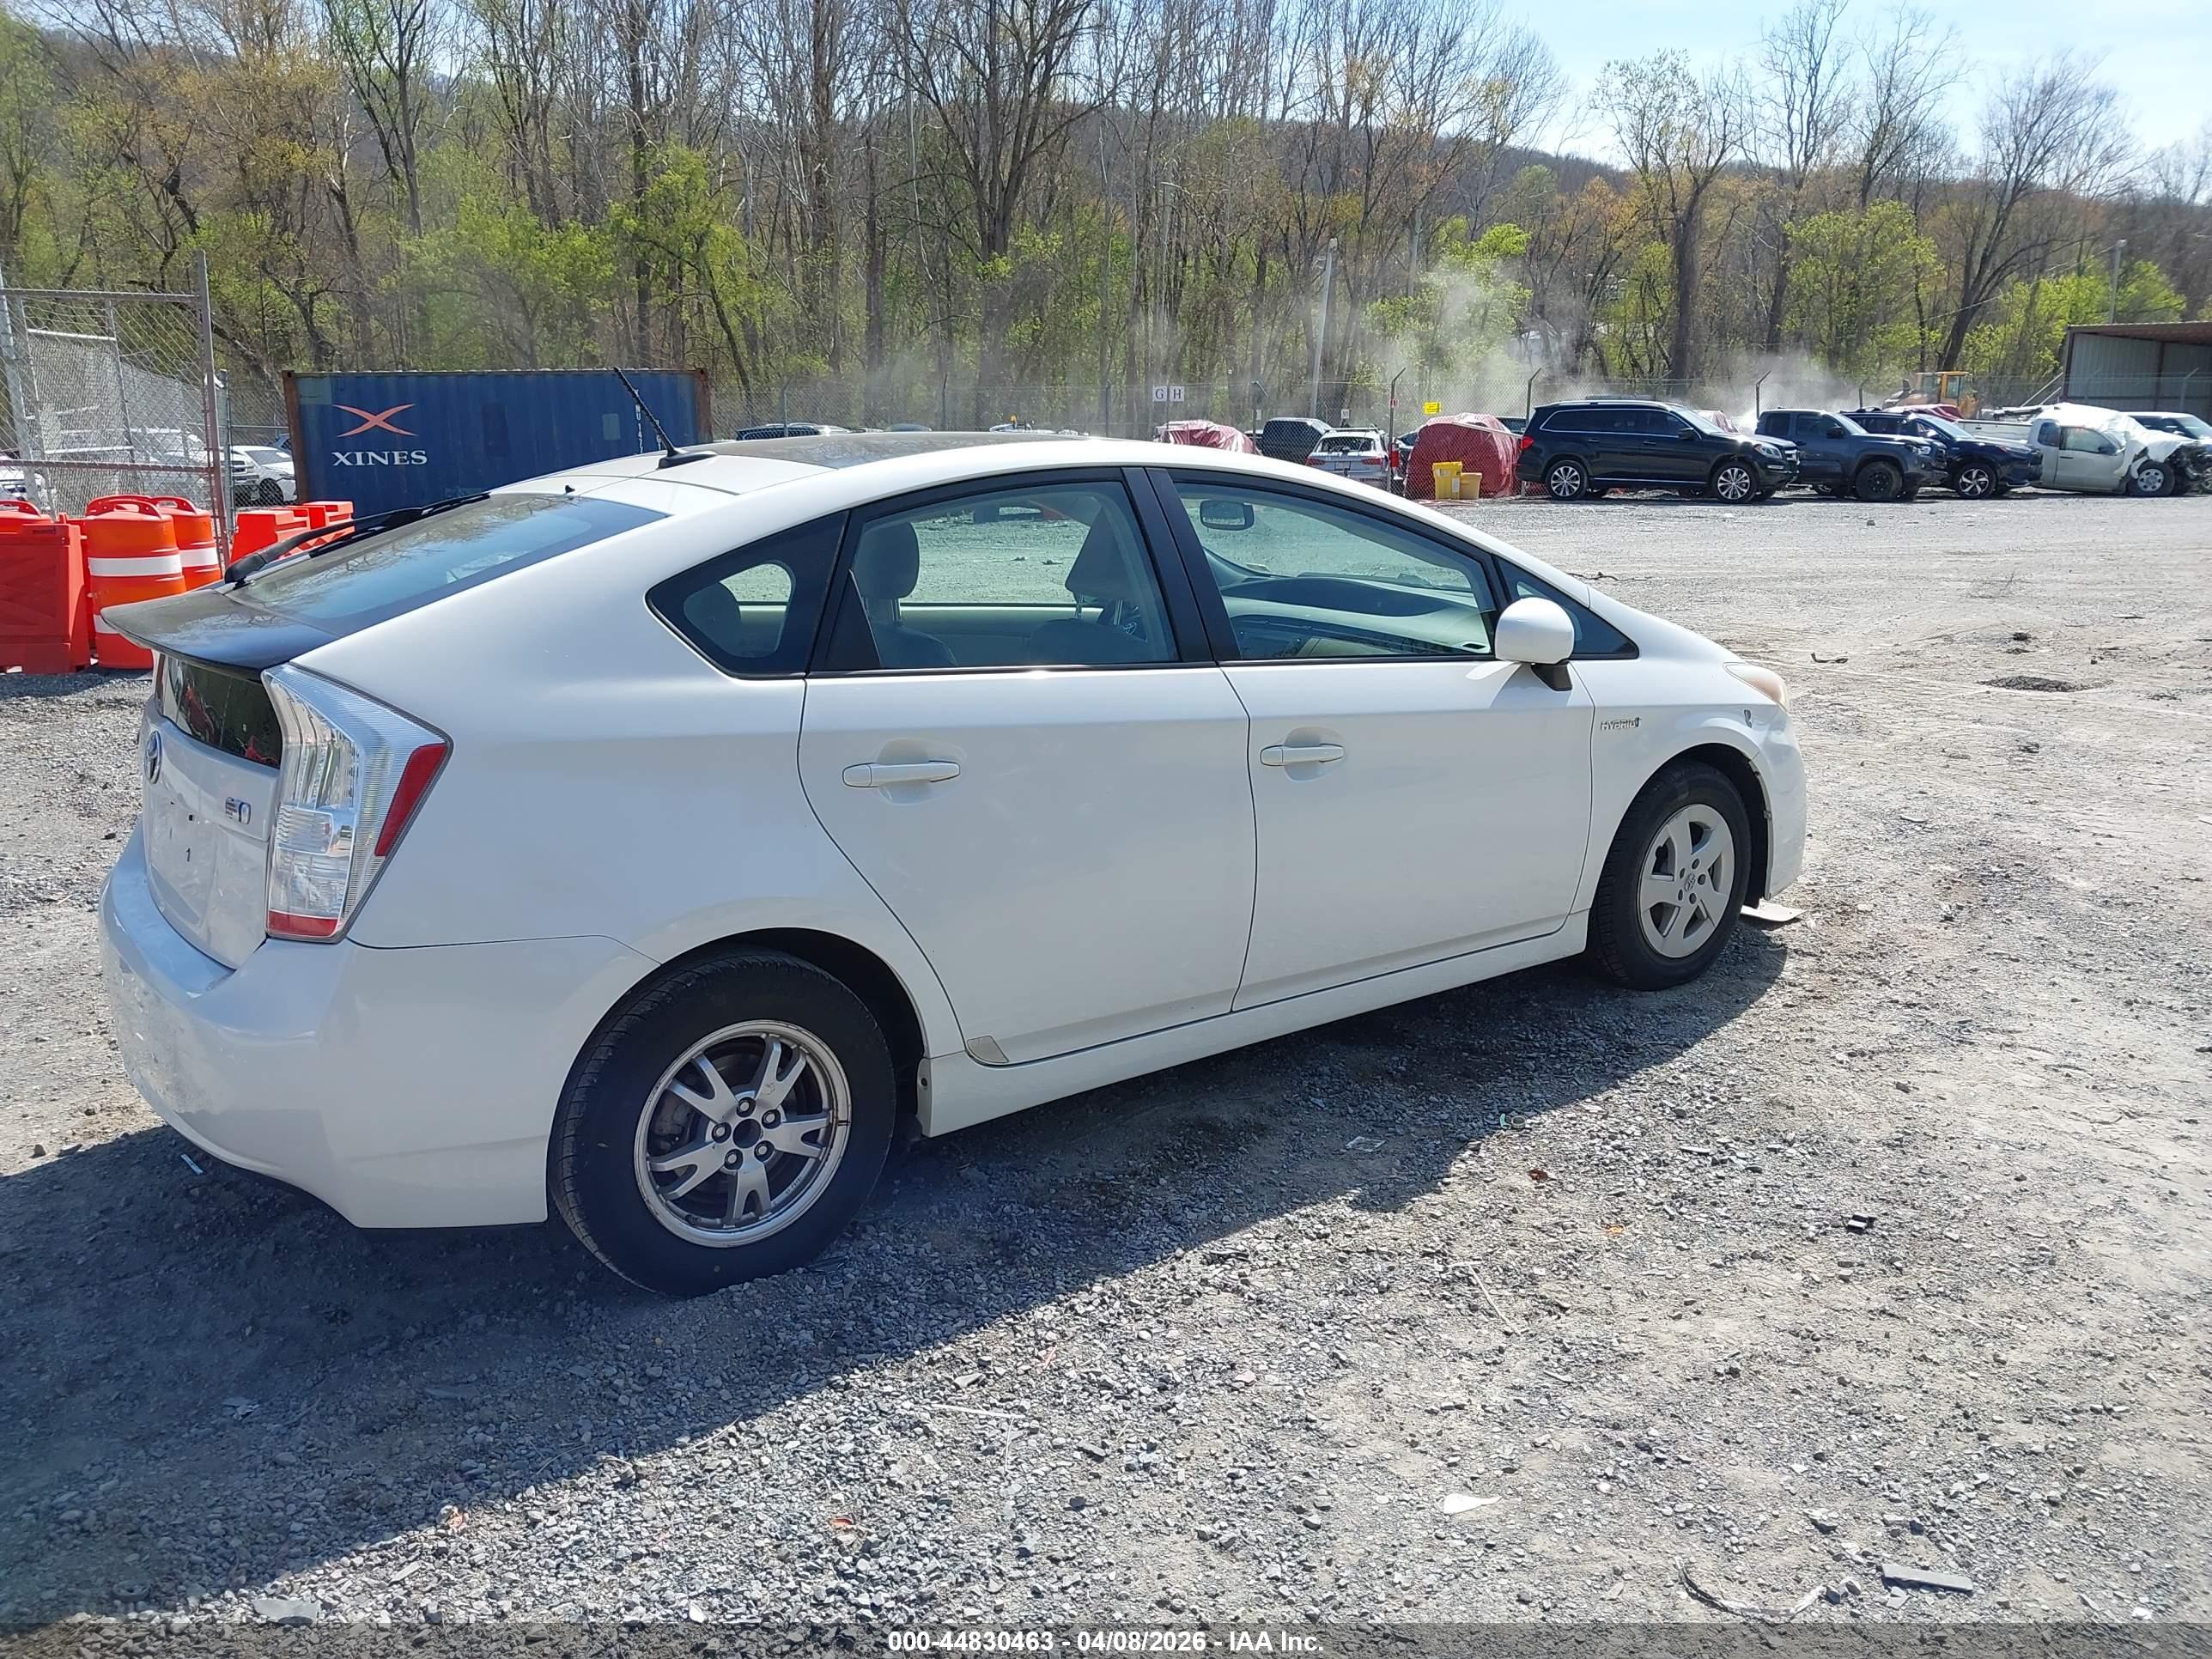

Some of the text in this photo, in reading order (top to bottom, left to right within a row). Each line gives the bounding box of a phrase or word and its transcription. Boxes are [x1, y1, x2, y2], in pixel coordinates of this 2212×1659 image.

[1155, 388, 1164, 399] G
[1174, 389, 1182, 399] H
[331, 449, 428, 467] XINES
[1600, 719, 1636, 731] HYBRID
